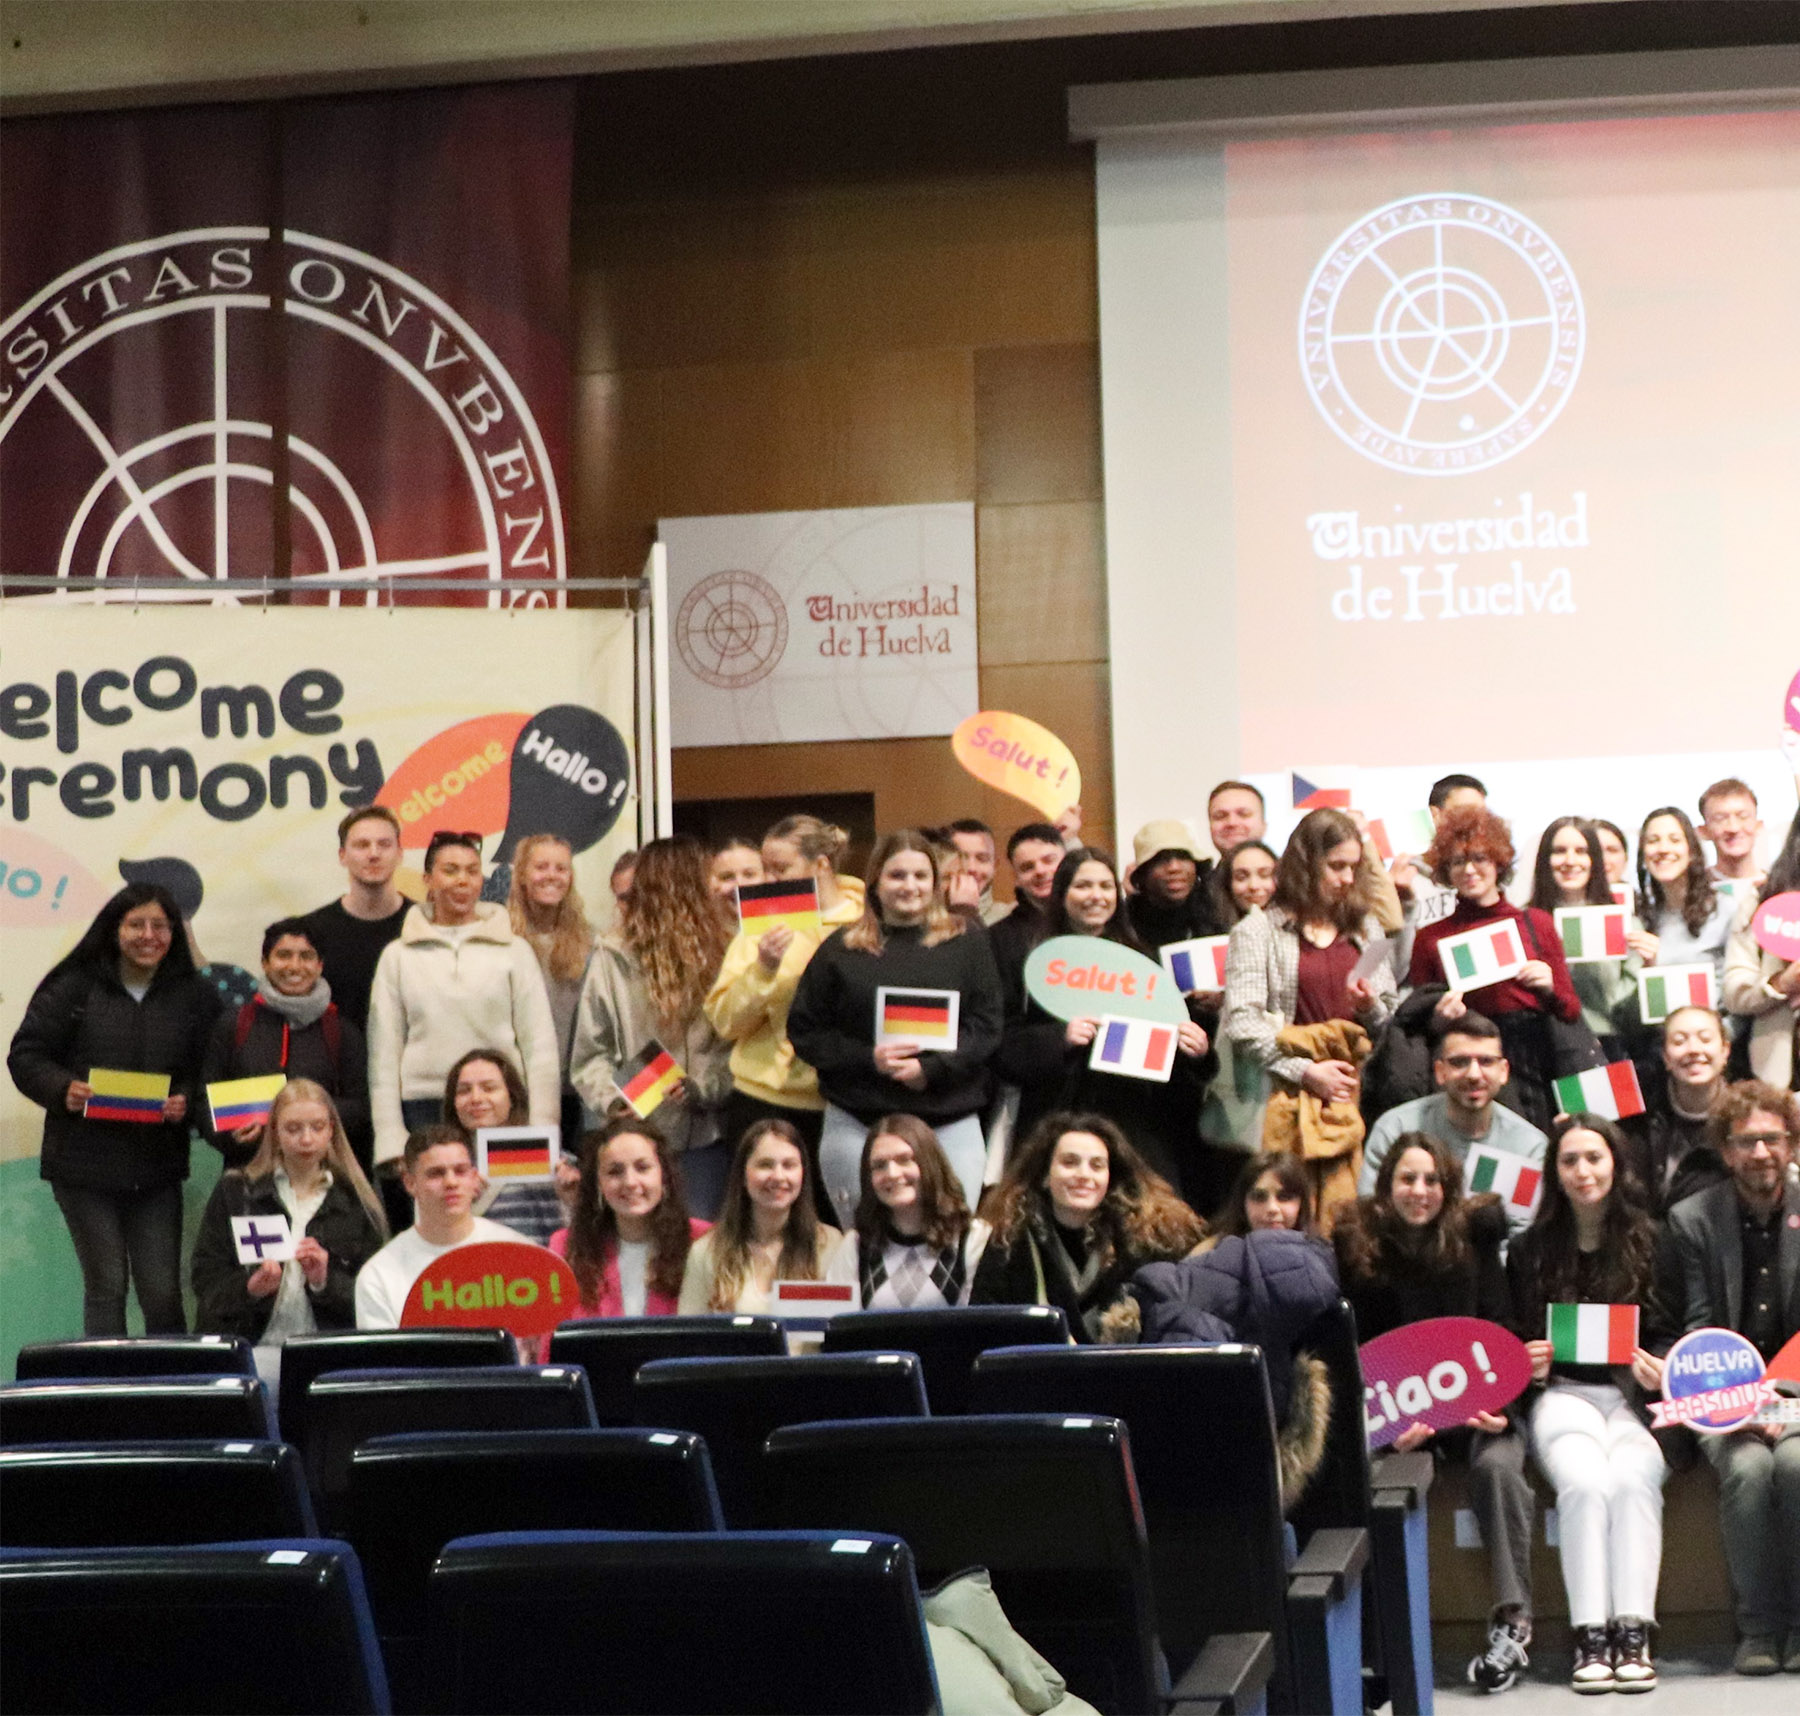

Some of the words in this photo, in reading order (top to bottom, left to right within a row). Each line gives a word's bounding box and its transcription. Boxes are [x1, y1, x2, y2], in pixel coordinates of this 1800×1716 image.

[1306, 491, 1590, 560] Universidad
[806, 585, 959, 622] Universidad
[1331, 565, 1393, 621] de
[1400, 561, 1577, 621] Huelva
[819, 626, 851, 657] de
[857, 623, 951, 657] Huelva
[521, 729, 608, 795] Hallo
[608, 779, 627, 807] !
[969, 725, 1052, 778] Salut
[1055, 766, 1069, 788] !
[1045, 958, 1137, 996] Salut
[1145, 973, 1158, 1000] !
[422, 1273, 539, 1311] Hallo
[550, 1271, 562, 1304] !
[1471, 1341, 1498, 1384] !
[1673, 1349, 1754, 1375] HUELVA
[1662, 1381, 1772, 1420] ERASMUS
